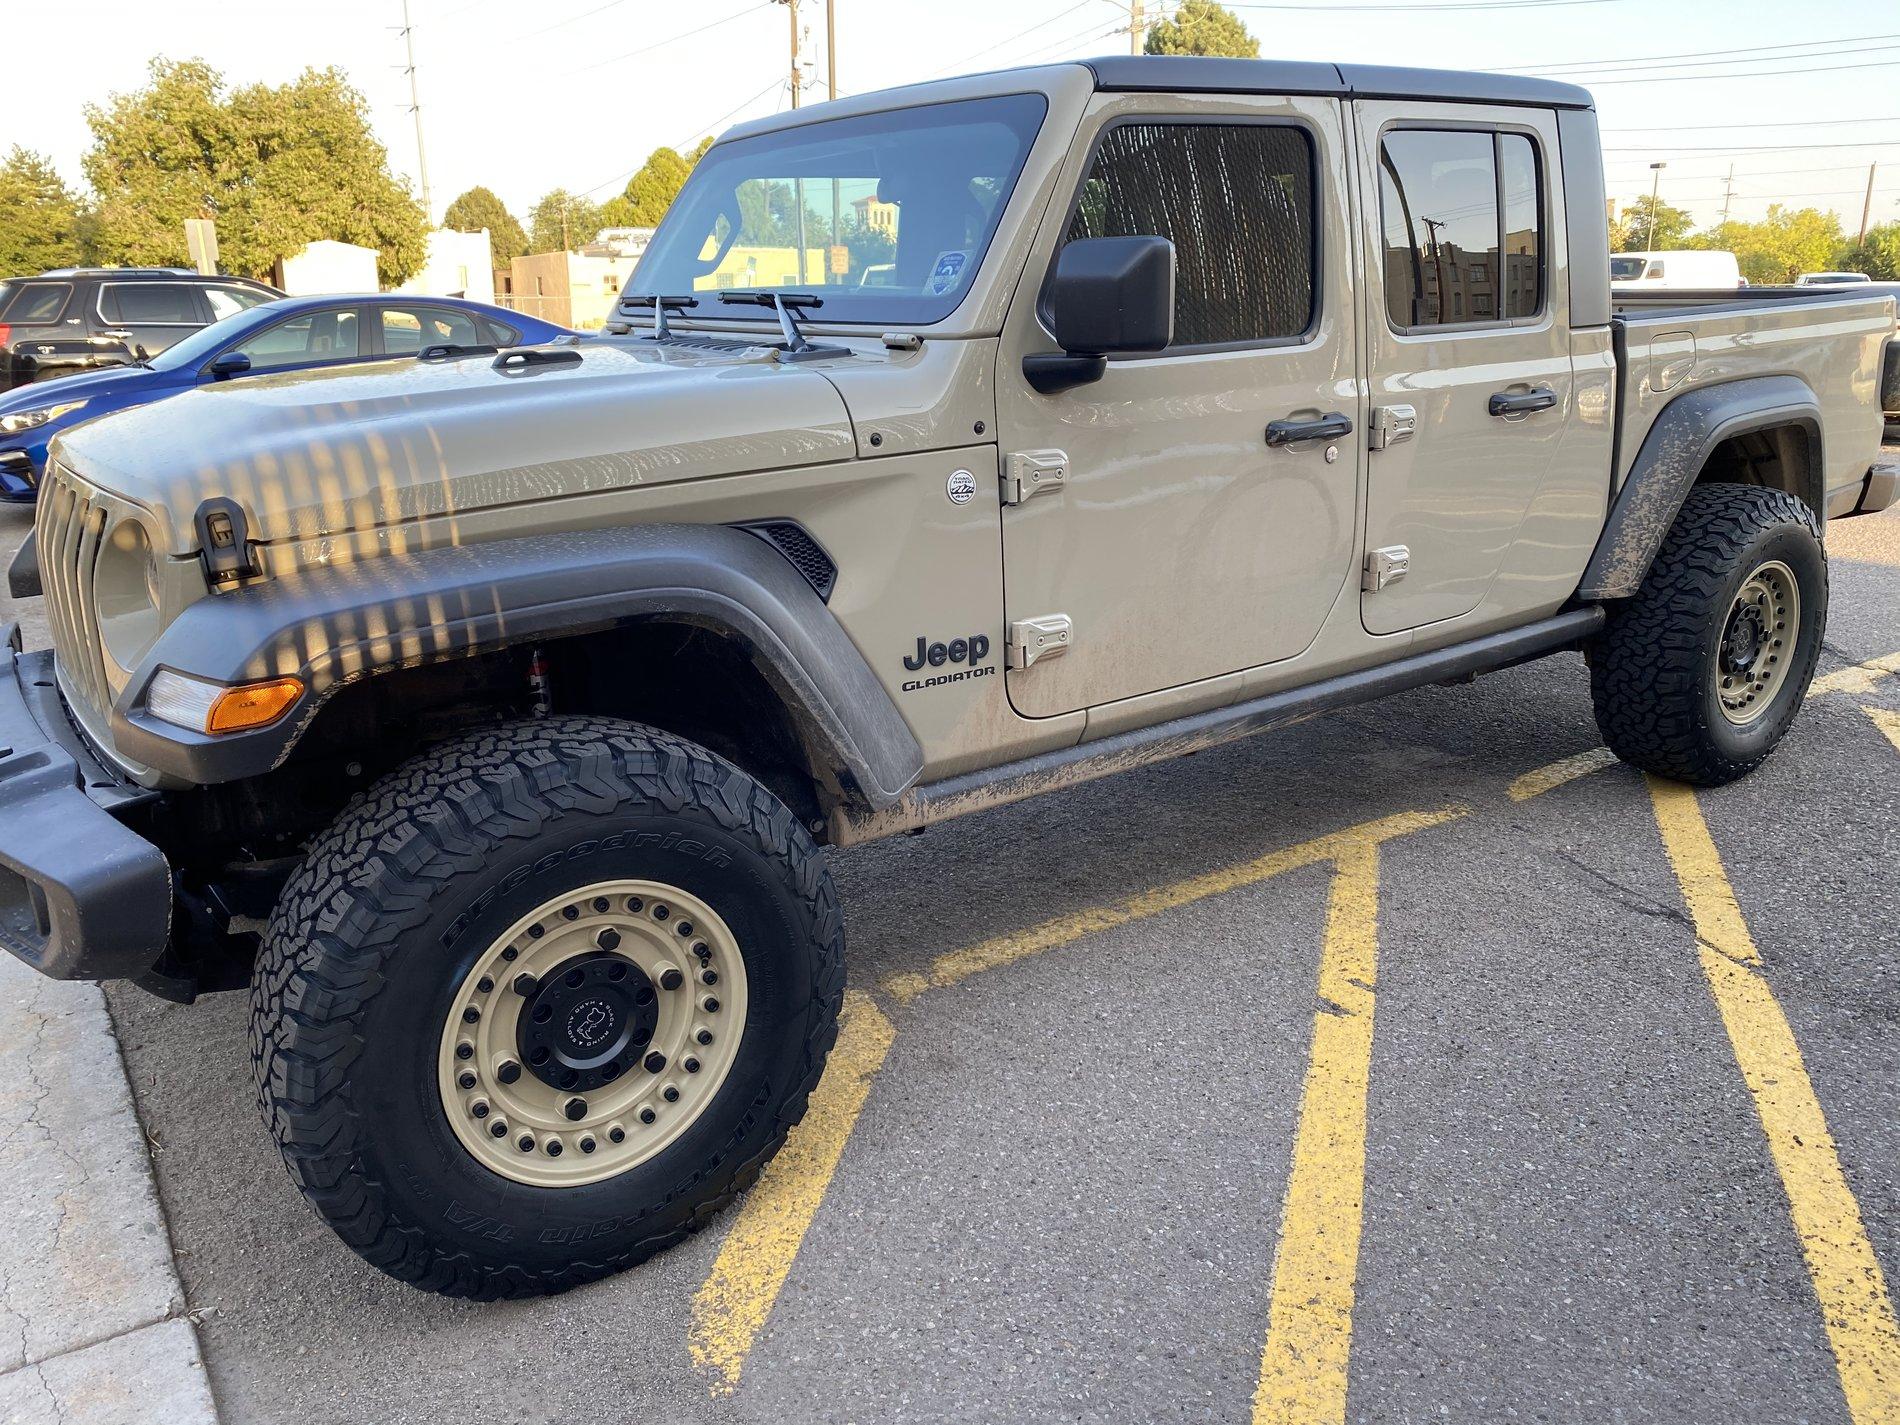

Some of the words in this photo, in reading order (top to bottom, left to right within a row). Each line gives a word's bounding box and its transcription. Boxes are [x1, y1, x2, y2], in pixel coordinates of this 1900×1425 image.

[903, 633, 990, 671] Jeep
[901, 666, 996, 692] GLADIATOR
[439, 828, 736, 951] BFGoodrich
[574, 1000, 595, 1013] HARD
[605, 1005, 614, 1027] BLACK
[586, 1029, 609, 1046] RHINO
